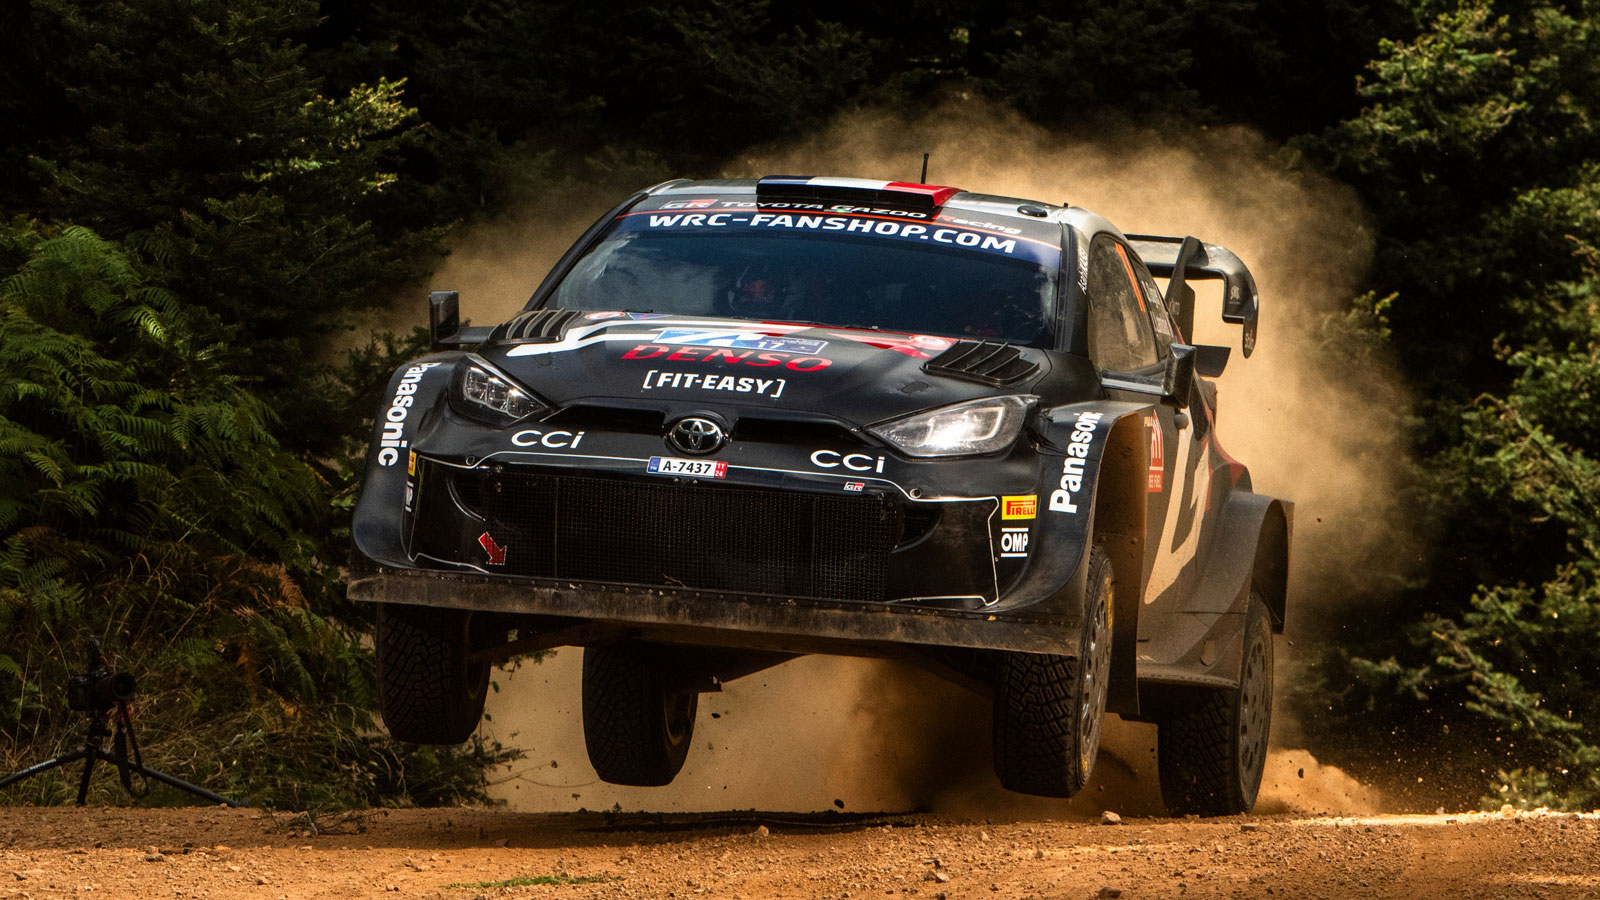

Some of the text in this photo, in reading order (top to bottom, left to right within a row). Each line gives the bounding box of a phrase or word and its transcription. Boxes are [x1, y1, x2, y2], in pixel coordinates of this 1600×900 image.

[662, 200, 1022, 235] GR TOYOTA GAZOO Racing
[649, 213, 1017, 254] WRC-FANSHOP.COM
[757, 341, 785, 350] 17
[620, 344, 833, 372] DENSO
[377, 362, 442, 467] Panasonic
[510, 429, 586, 449] CCi
[662, 460, 712, 474] A-7437
[810, 449, 886, 474] CCi
[845, 482, 864, 492] GR
[1005, 500, 1036, 516] PIRELLI
[1001, 533, 1029, 552] OMP
